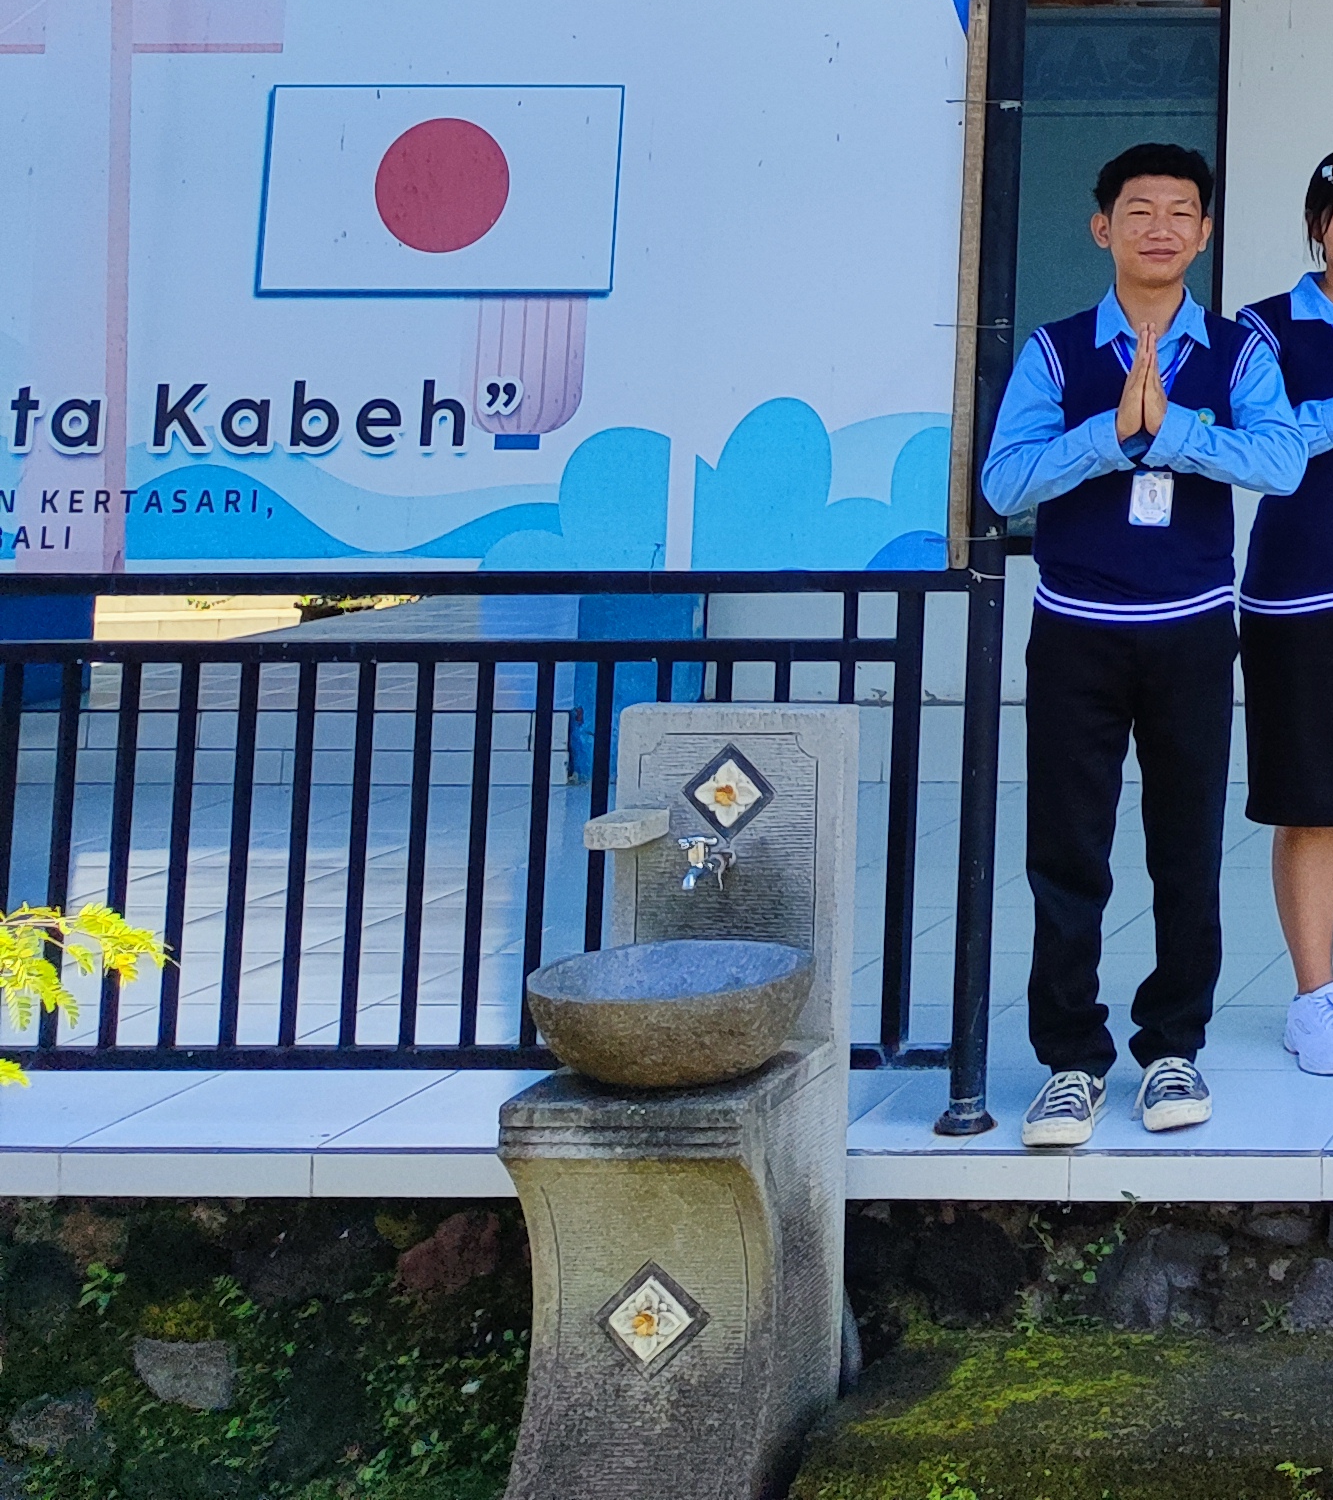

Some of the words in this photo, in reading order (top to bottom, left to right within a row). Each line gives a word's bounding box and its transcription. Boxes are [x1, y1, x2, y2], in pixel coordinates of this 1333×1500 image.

[10, 385, 103, 448] ta
[41, 489, 274, 520] KERTASARI,
[0, 525, 72, 550] ALI
